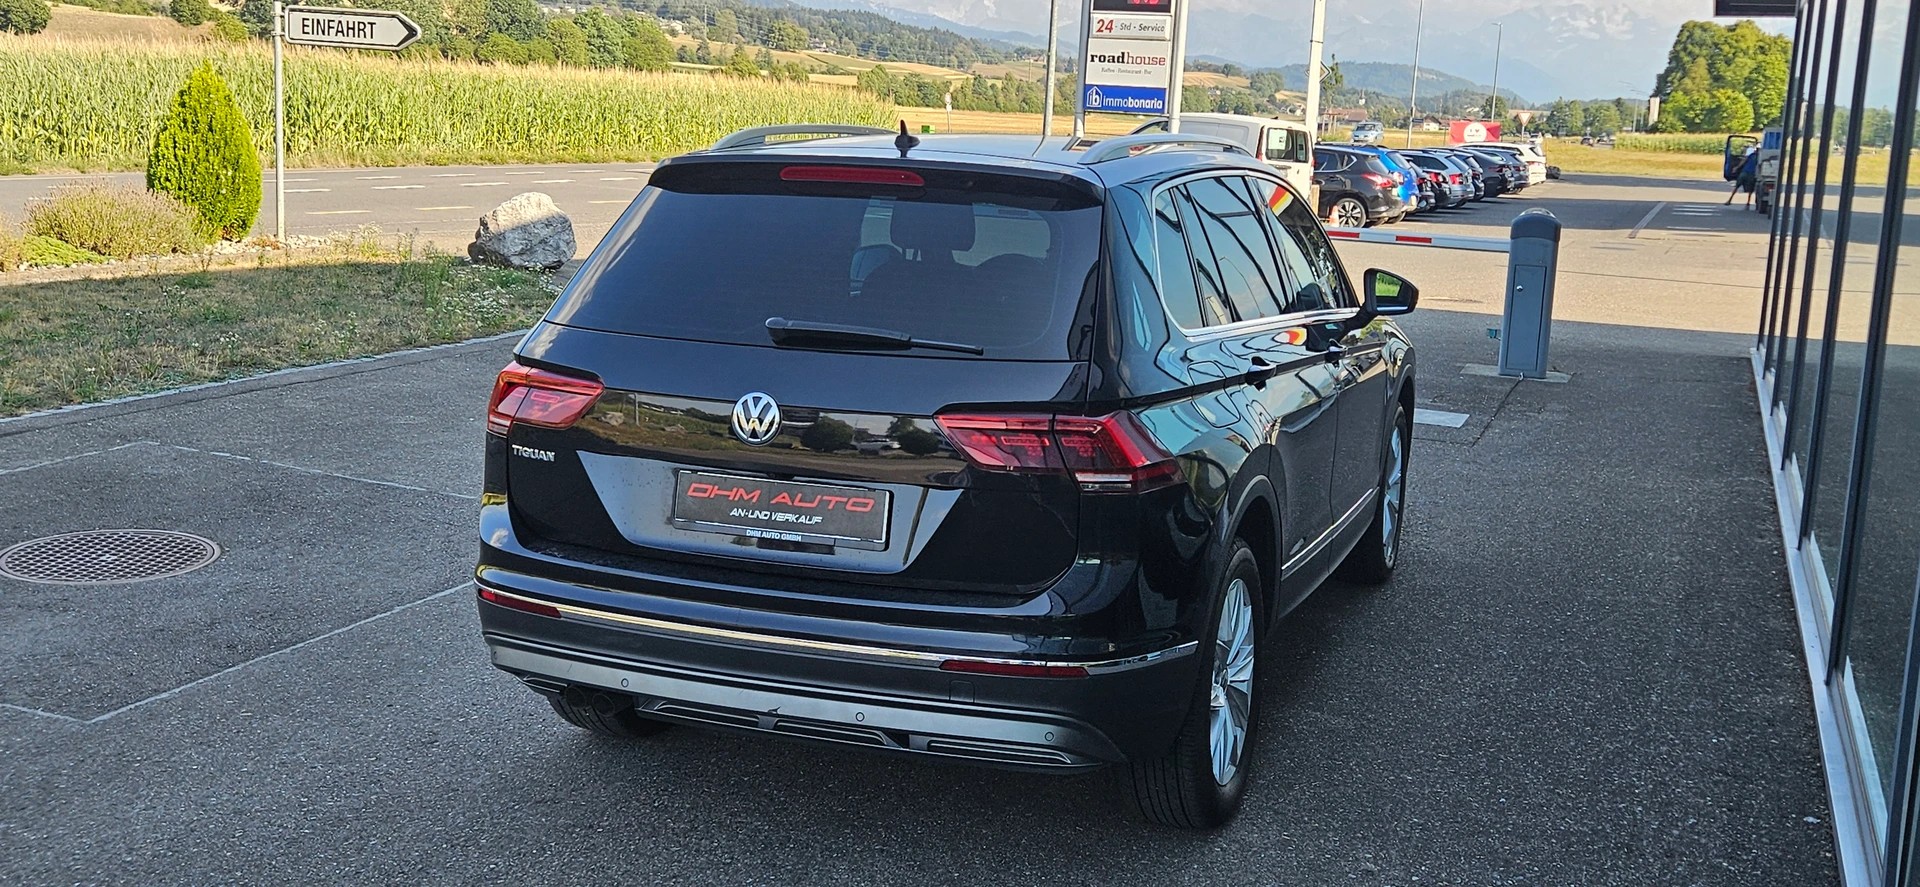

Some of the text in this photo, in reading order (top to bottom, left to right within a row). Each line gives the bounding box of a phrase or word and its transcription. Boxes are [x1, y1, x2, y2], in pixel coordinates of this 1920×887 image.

[301, 17, 377, 39] EINFAHRT
[1095, 18, 1165, 33] 24 Std Service
[1089, 51, 1166, 66] roadhouse
[1103, 95, 1163, 109] immobonaria
[732, 391, 781, 445] VW
[511, 444, 556, 462] TIGUAN
[687, 482, 875, 512] DHM AUTO
[771, 511, 823, 525] VERKAUF
[746, 529, 801, 542] DHM AUTO GMBH
